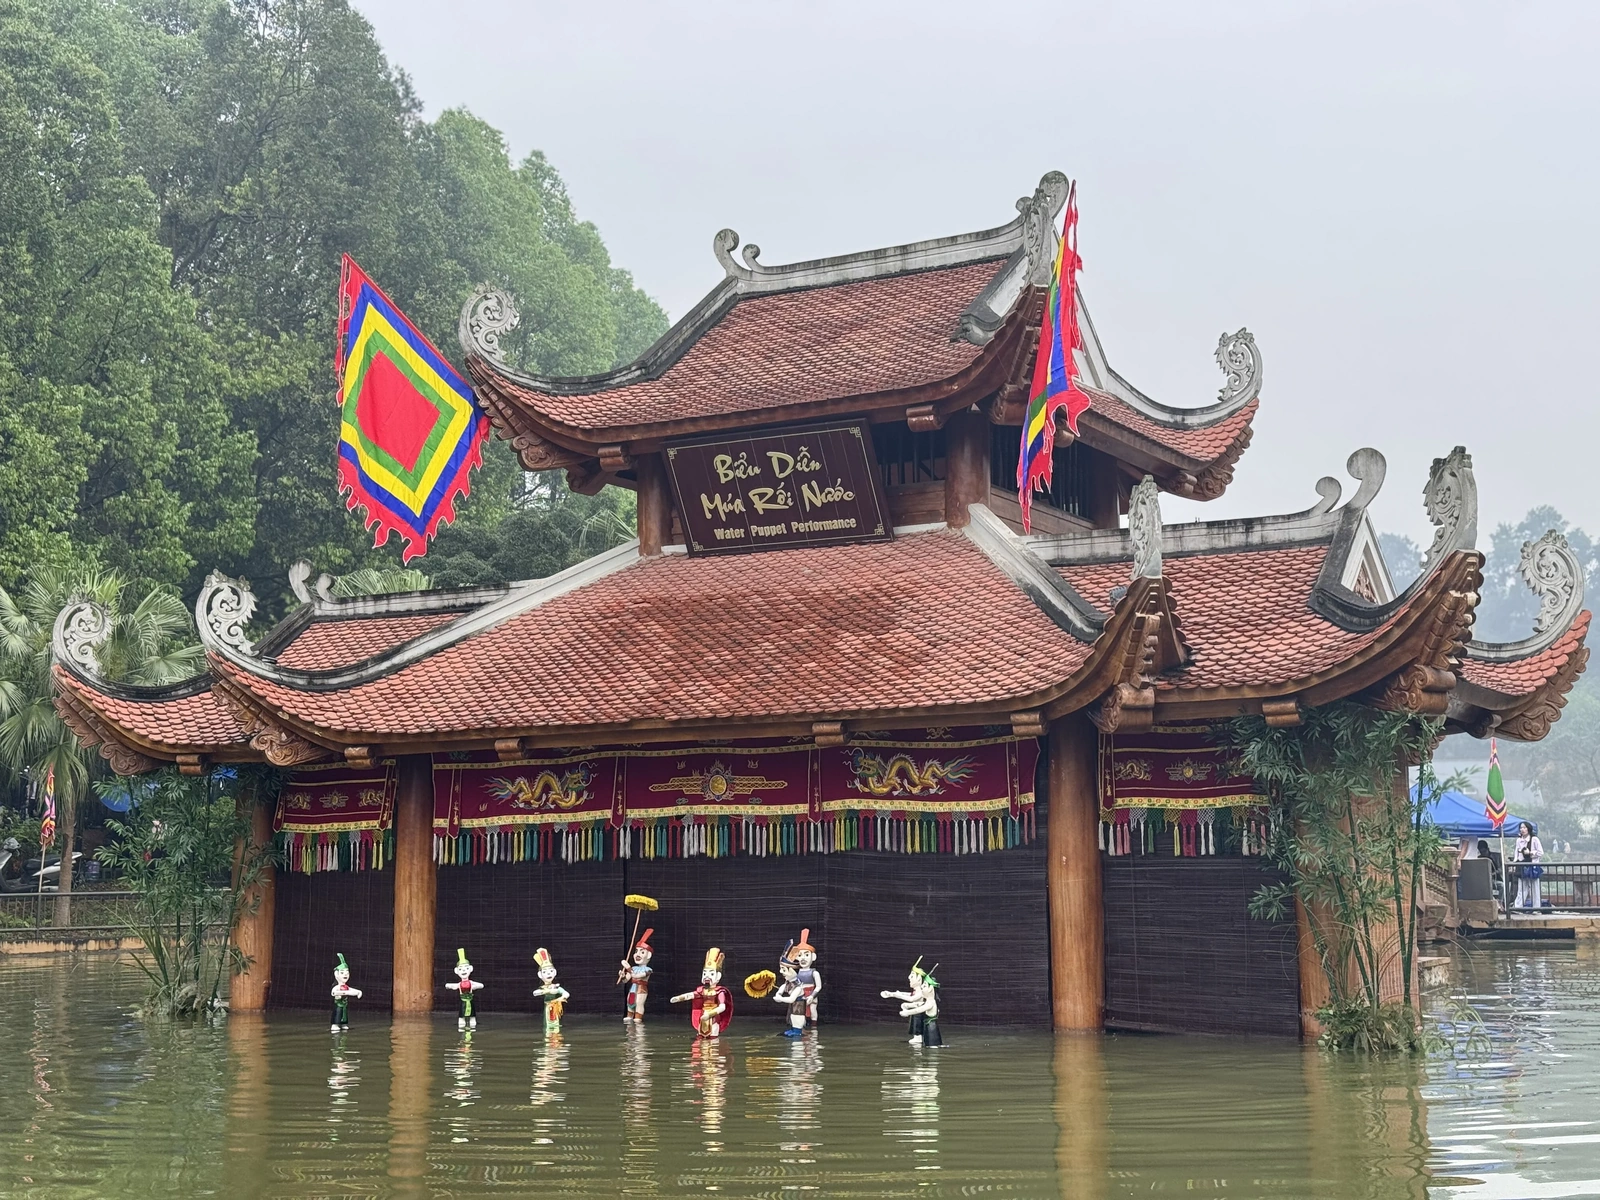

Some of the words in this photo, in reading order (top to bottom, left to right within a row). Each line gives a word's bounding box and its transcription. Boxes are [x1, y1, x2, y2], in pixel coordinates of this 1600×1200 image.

[713, 451, 762, 484] Biểu
[766, 445, 823, 479] Diễn
[700, 492, 746, 522] Múa
[748, 481, 794, 515] Rối
[714, 527, 745, 540] Water
[750, 523, 788, 538] Puppet
[790, 517, 857, 533] Performance
